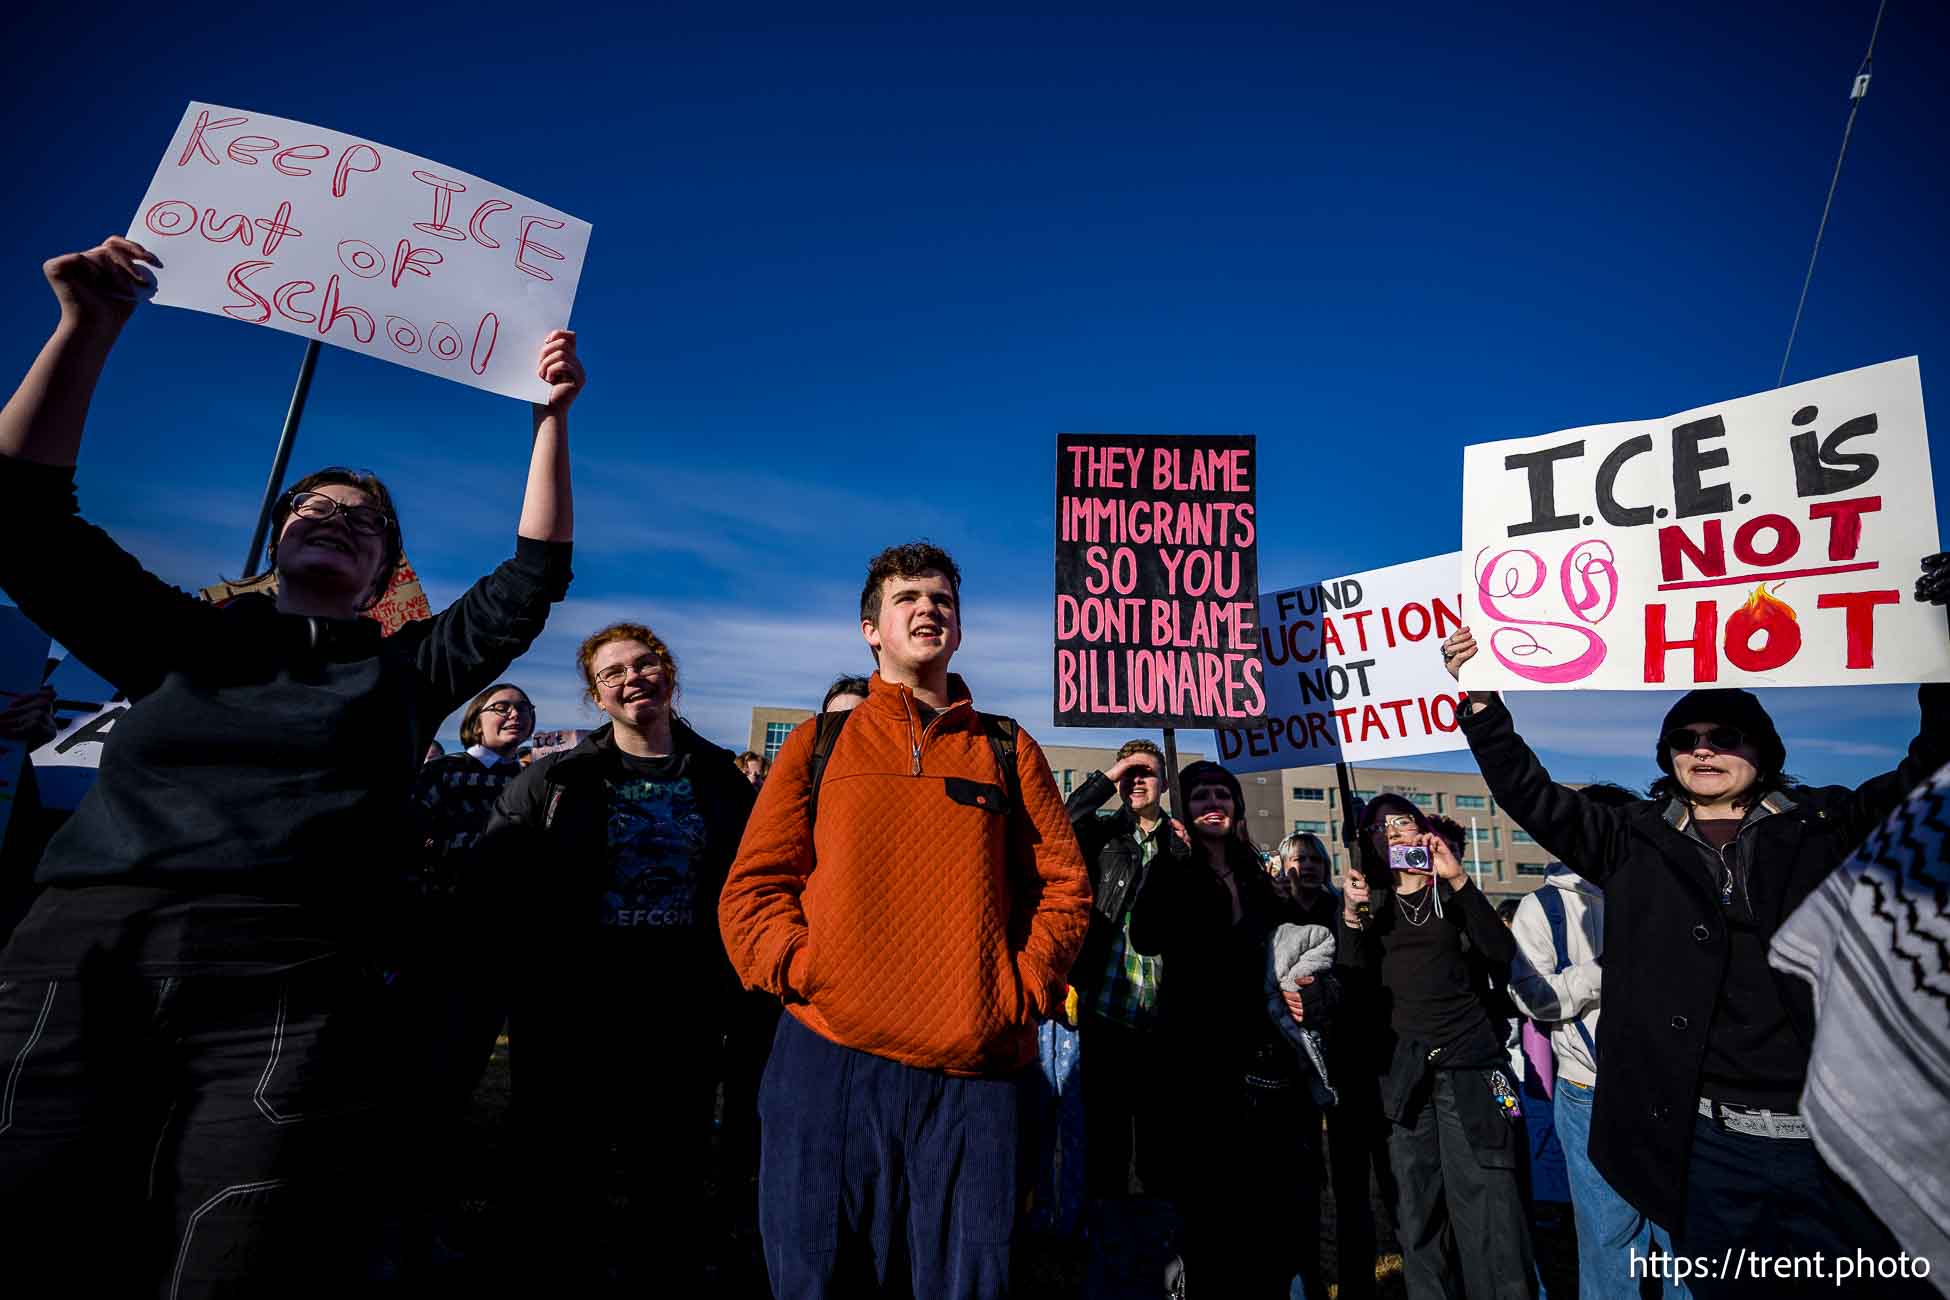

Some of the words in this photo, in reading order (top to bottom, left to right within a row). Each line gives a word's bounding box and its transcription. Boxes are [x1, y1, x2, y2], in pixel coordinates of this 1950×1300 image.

[179, 110, 381, 197] Keep
[412, 170, 566, 281] ICE
[222, 260, 500, 375] School
[1067, 446, 1145, 489] THEY
[1153, 449, 1250, 492] BLAME
[1504, 415, 1752, 538] I.C.E.
[1062, 496, 1255, 548] IMMIGRANTS
[1658, 496, 1882, 582] NOT
[1085, 546, 1137, 595] SO
[1159, 549, 1240, 598] YOU
[1276, 579, 1363, 620] FUND
[1057, 595, 1145, 644] DONT
[1151, 599, 1258, 650] BLAME
[1262, 593, 1462, 667] UCATION
[1643, 588, 1900, 684] HOT
[1058, 650, 1266, 719] BILLIONAIRES
[1298, 659, 1376, 705] NOT
[533, 733, 567, 748] ICE
[1218, 692, 1468, 760] DEPORTATIO
